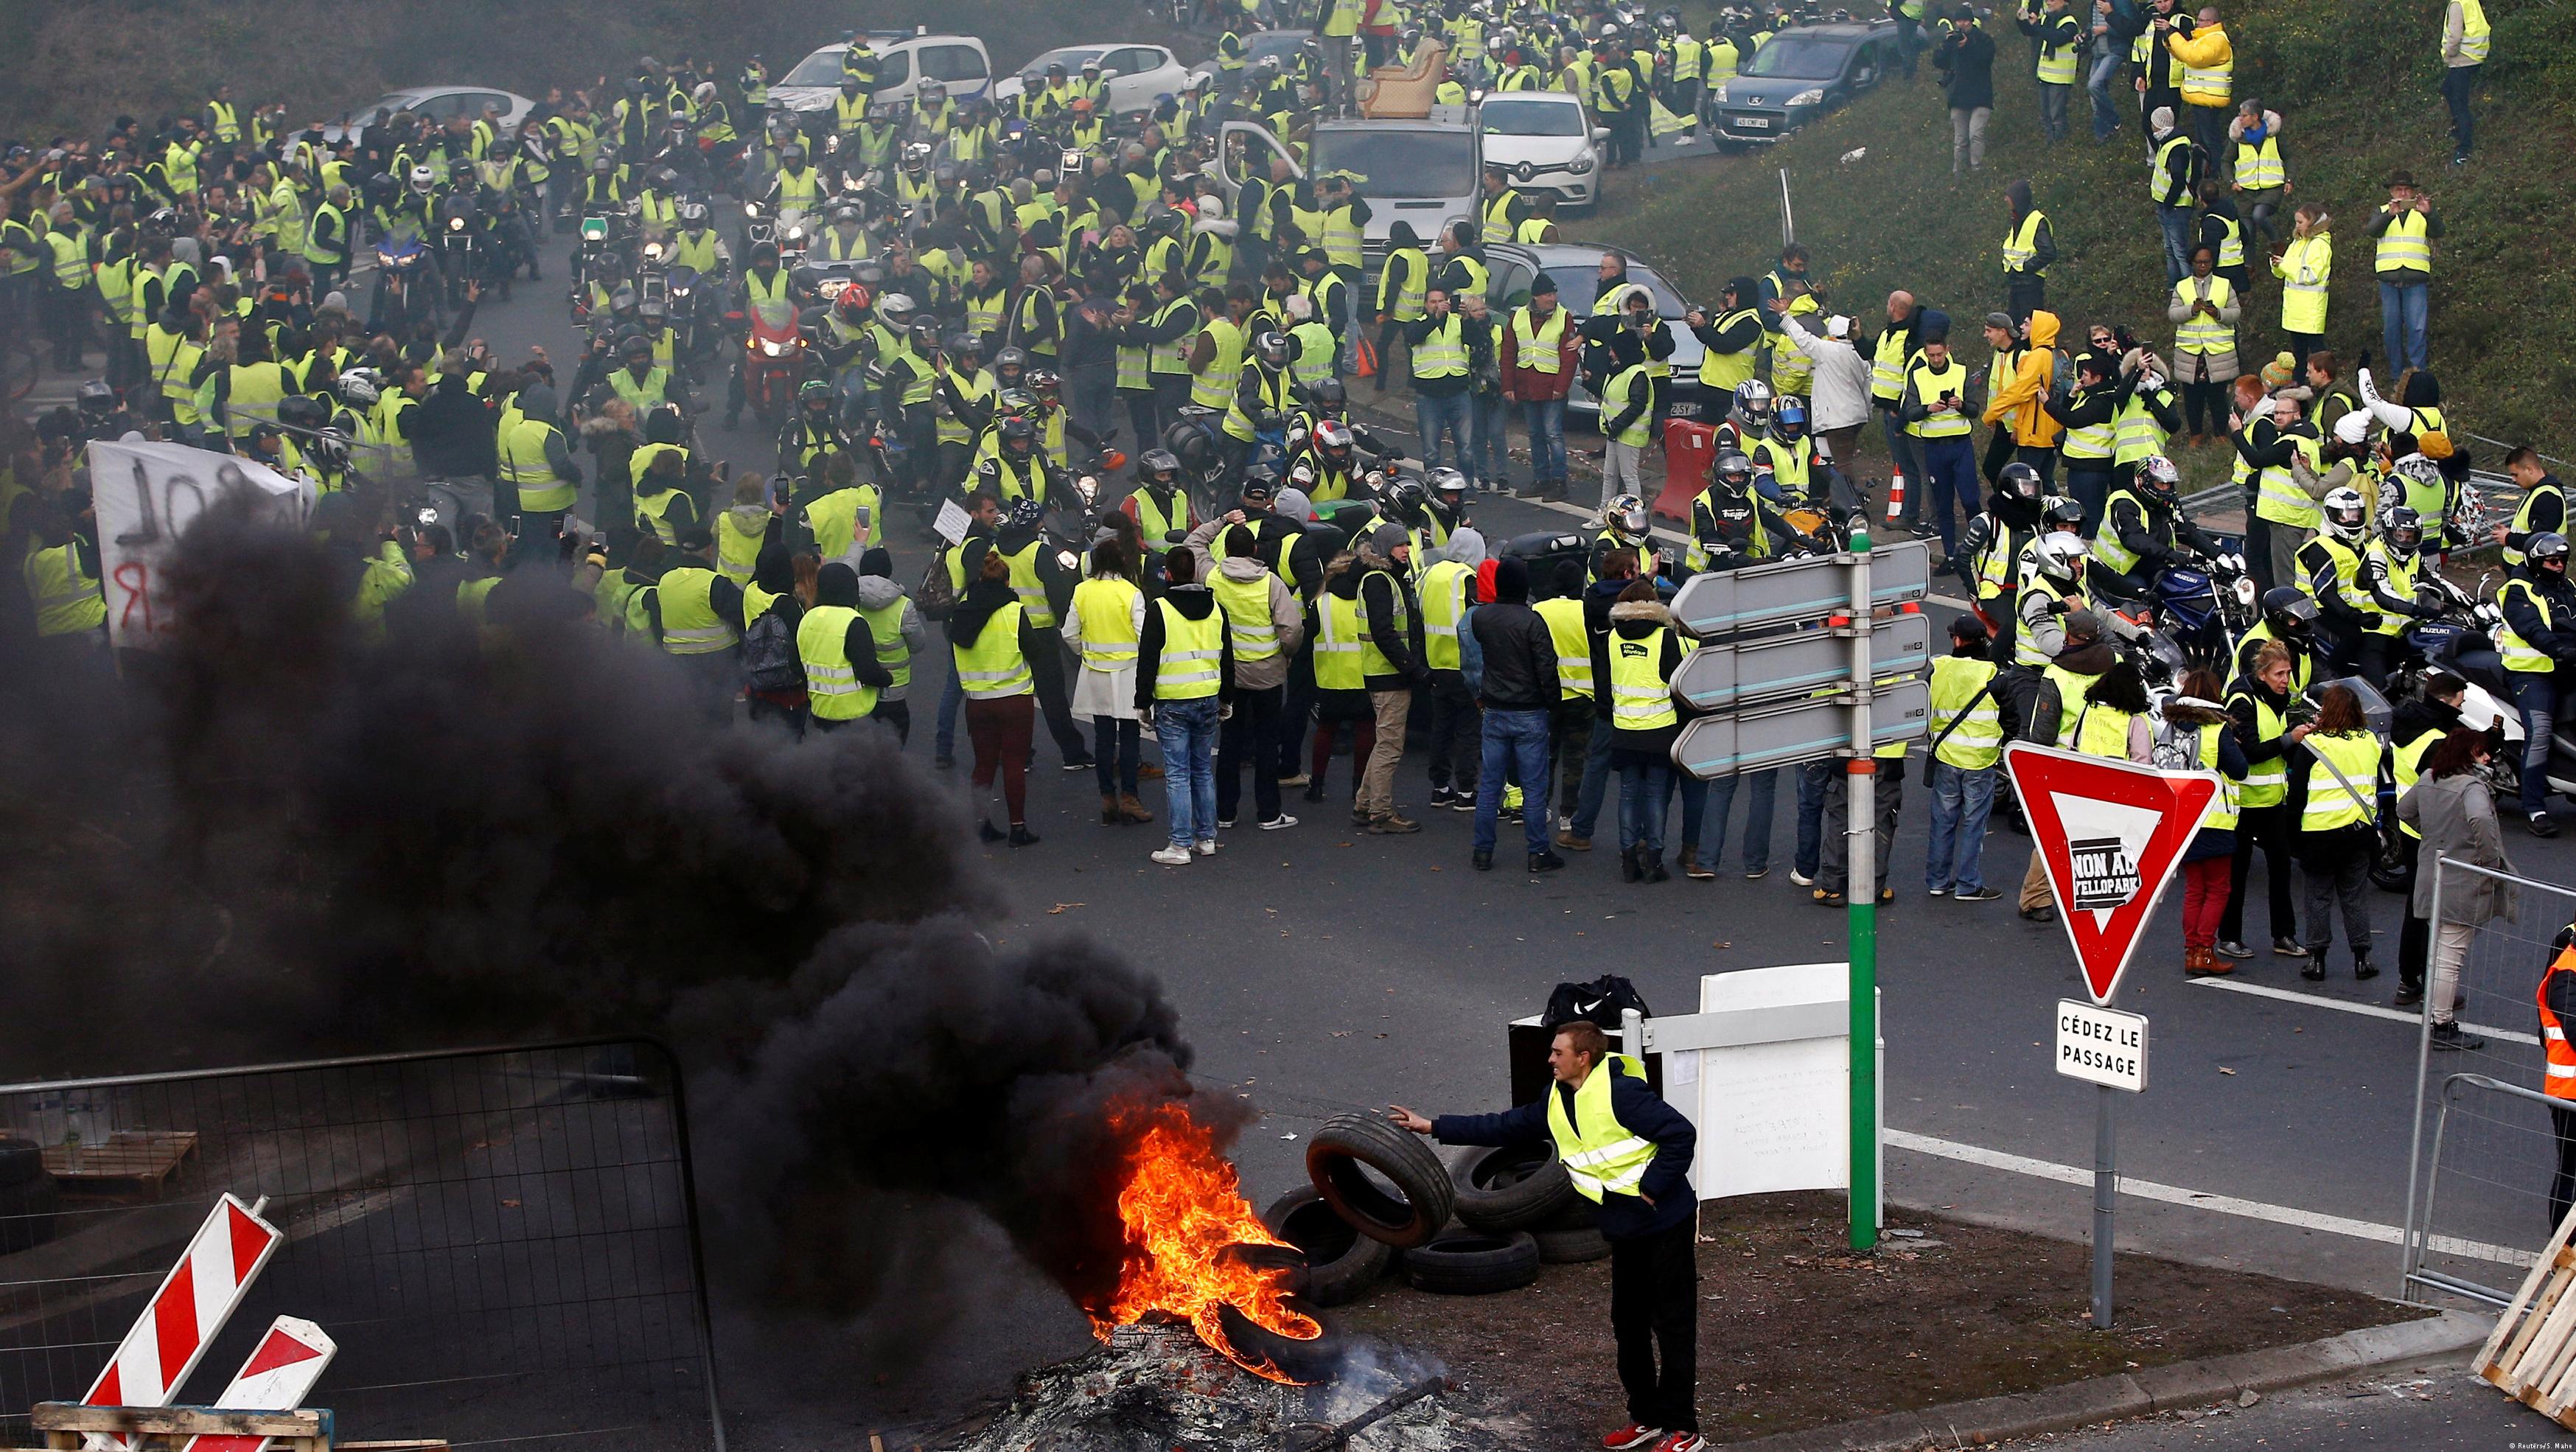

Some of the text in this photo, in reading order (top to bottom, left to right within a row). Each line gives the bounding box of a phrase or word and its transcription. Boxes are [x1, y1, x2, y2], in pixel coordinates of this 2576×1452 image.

[2174, 573, 2198, 584] SUZUKI
[2420, 626, 2450, 635] SUZUKI
[2073, 852, 2108, 879] NON
[2062, 1015, 2138, 1048] CÉDEZ LE
[2064, 1045, 2135, 1076] PASSAGE
